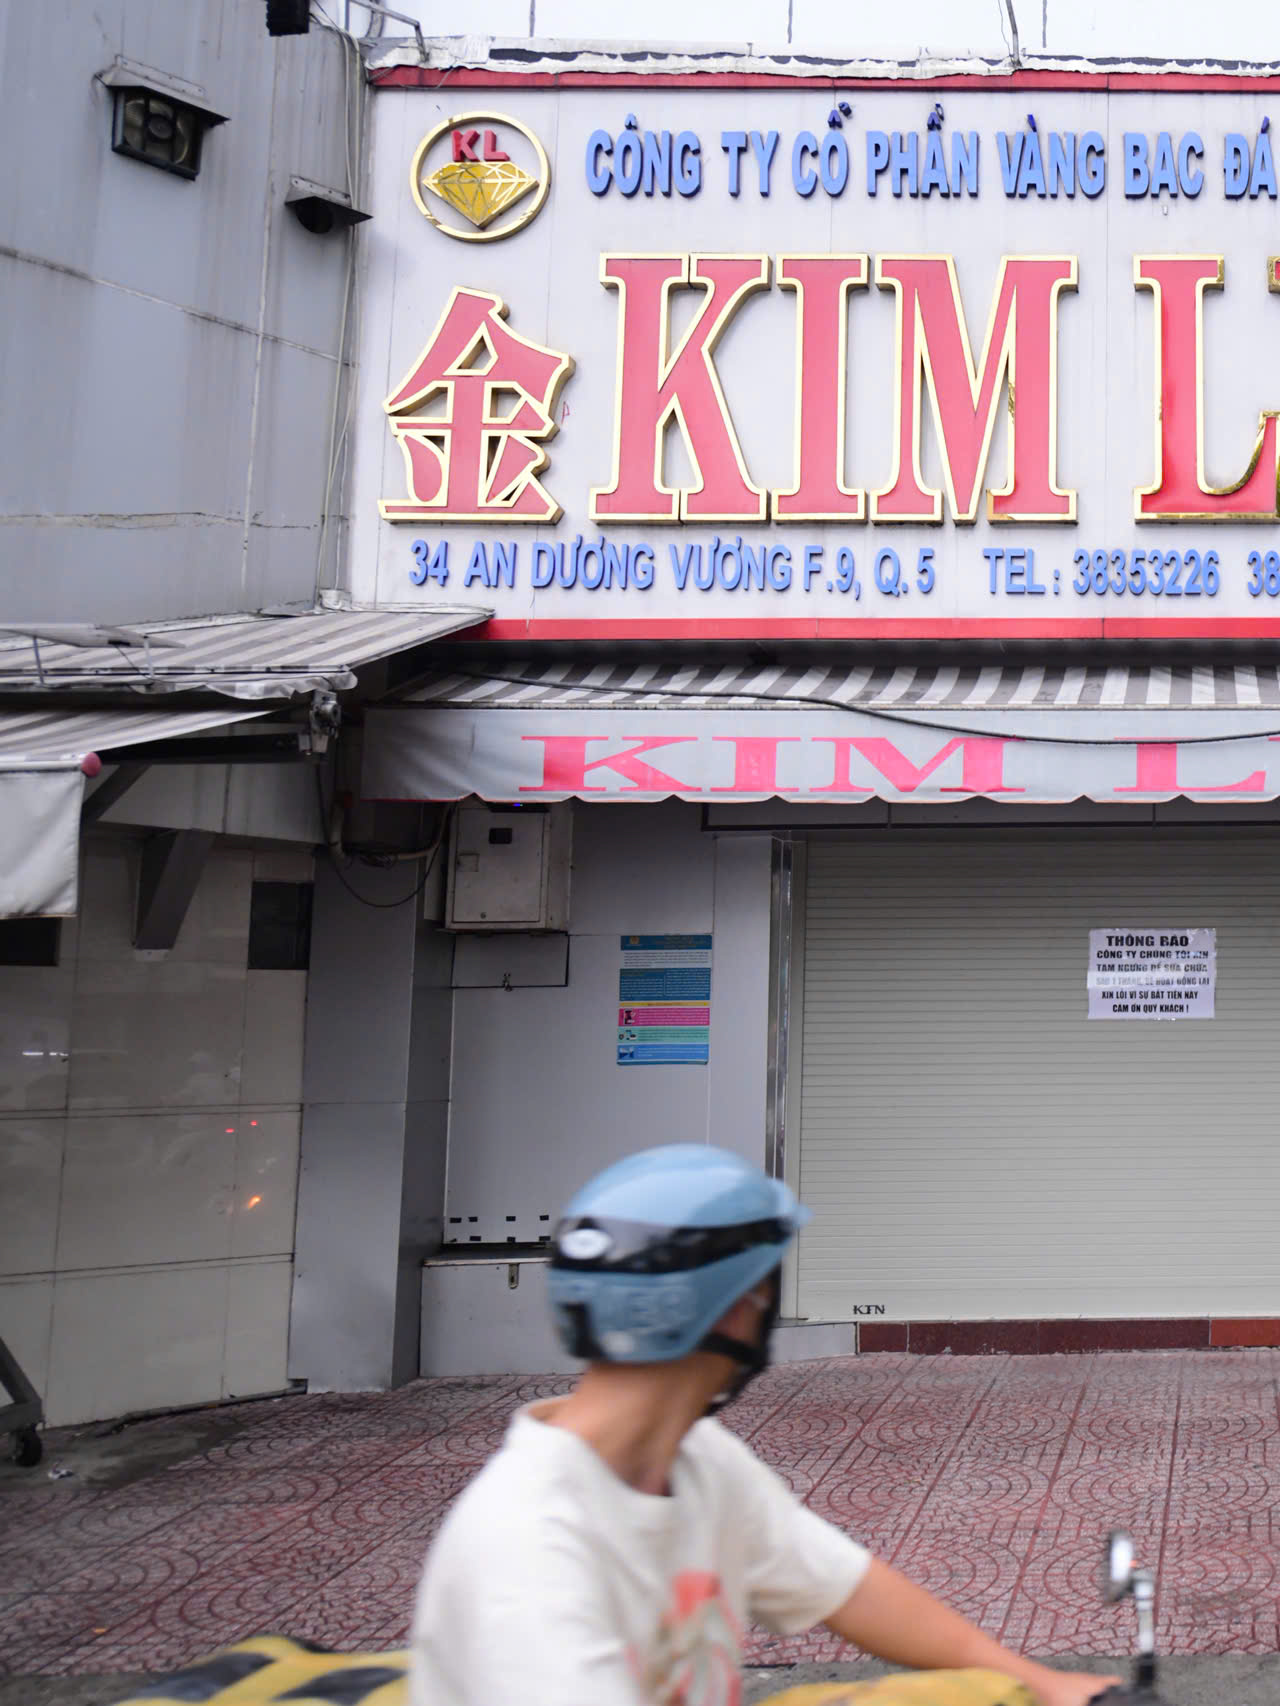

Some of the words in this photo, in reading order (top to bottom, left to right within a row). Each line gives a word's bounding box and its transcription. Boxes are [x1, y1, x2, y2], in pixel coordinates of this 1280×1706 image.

[451, 129, 511, 162] KL
[585, 113, 701, 198] CÔNG
[721, 130, 780, 198] TY
[791, 101, 853, 198] CỔ
[996, 114, 1105, 200] VÀNG
[1224, 115, 1279, 200] ĐÁ
[377, 285, 575, 525] 金
[588, 251, 1079, 526] KIM
[409, 538, 450, 587] 34
[463, 541, 518, 588] AN
[530, 534, 655, 592] DƯƠNG
[669, 536, 793, 592] VƯƠNG
[1072, 547, 1221, 596] 38353226
[518, 735, 1026, 793] KIM
[1096, 949, 1123, 959] CÔNG
[1125, 950, 1137, 959] TY
[1105, 933, 1155, 947] THÔNG
[1101, 990, 1114, 1000] XIN
